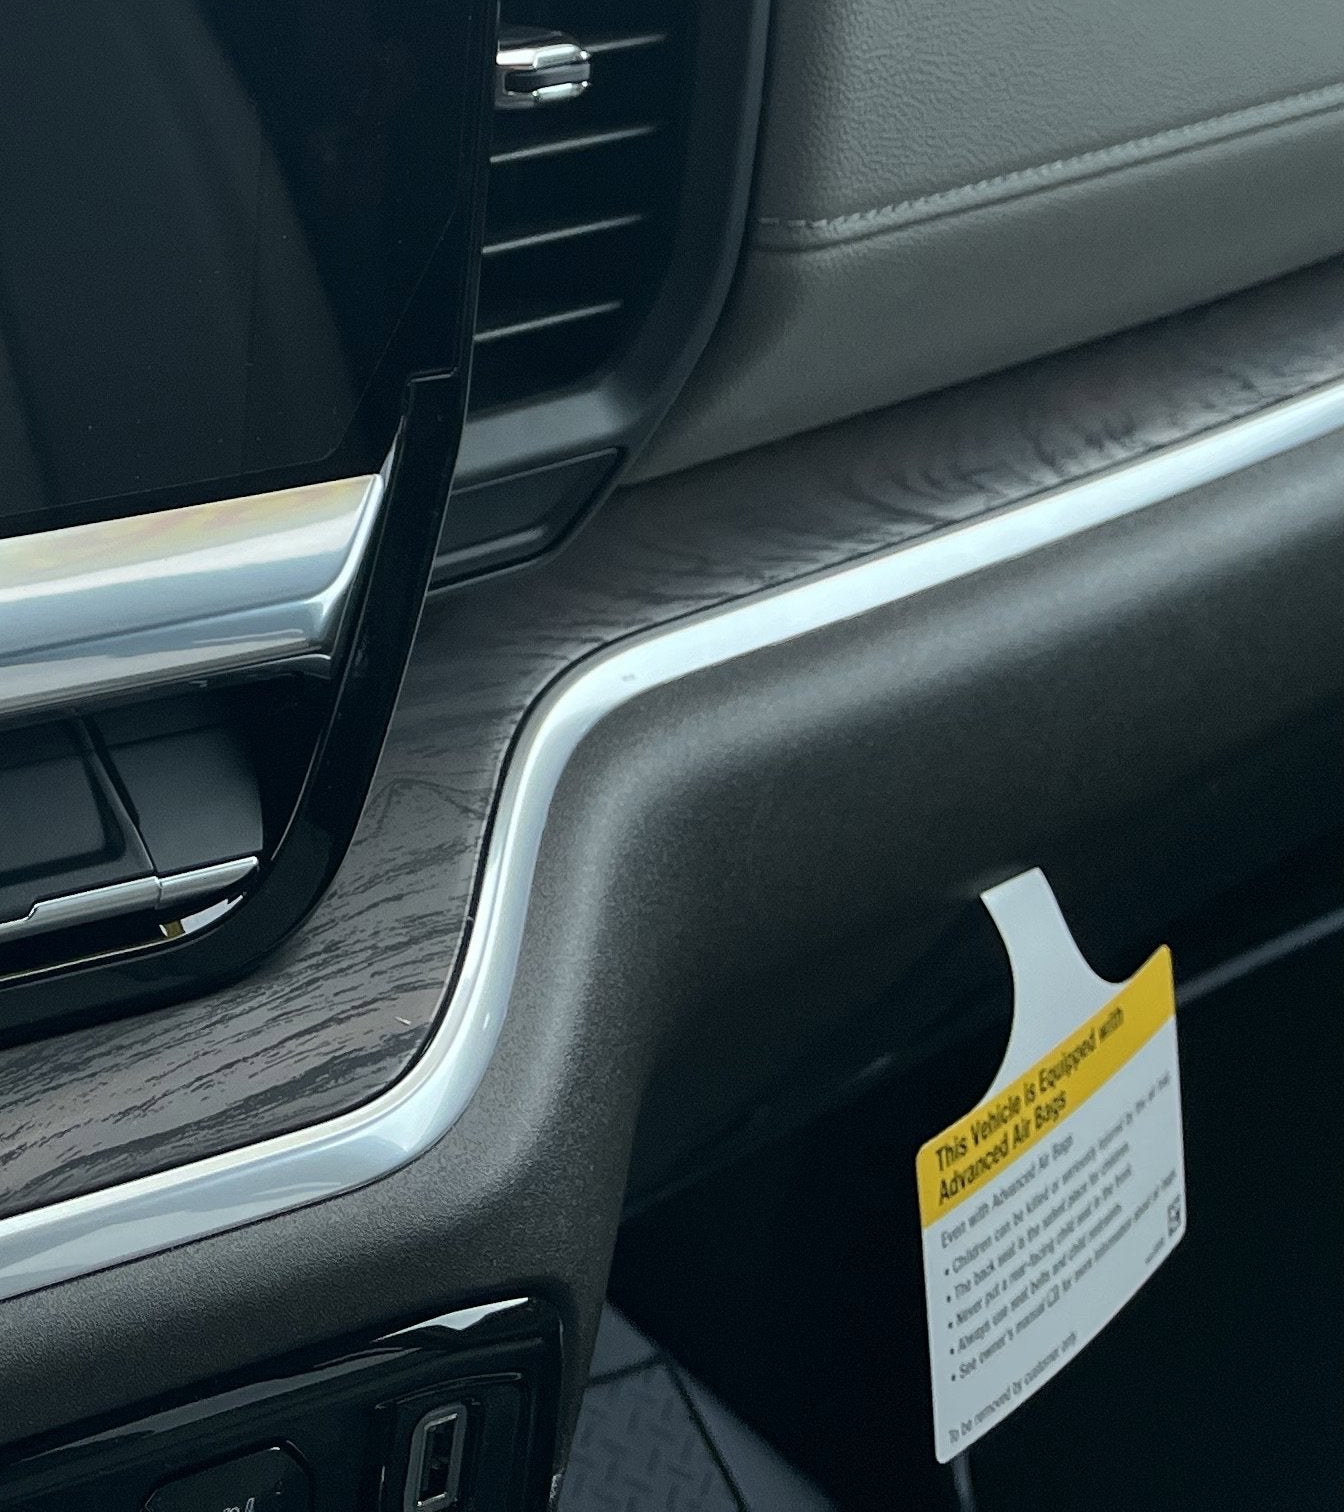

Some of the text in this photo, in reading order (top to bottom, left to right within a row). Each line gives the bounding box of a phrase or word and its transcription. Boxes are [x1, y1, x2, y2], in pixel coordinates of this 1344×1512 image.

[936, 1007, 1124, 1171] This Vehicle is Equipped with
[939, 1090, 1066, 1205] Advanced Air Bags
